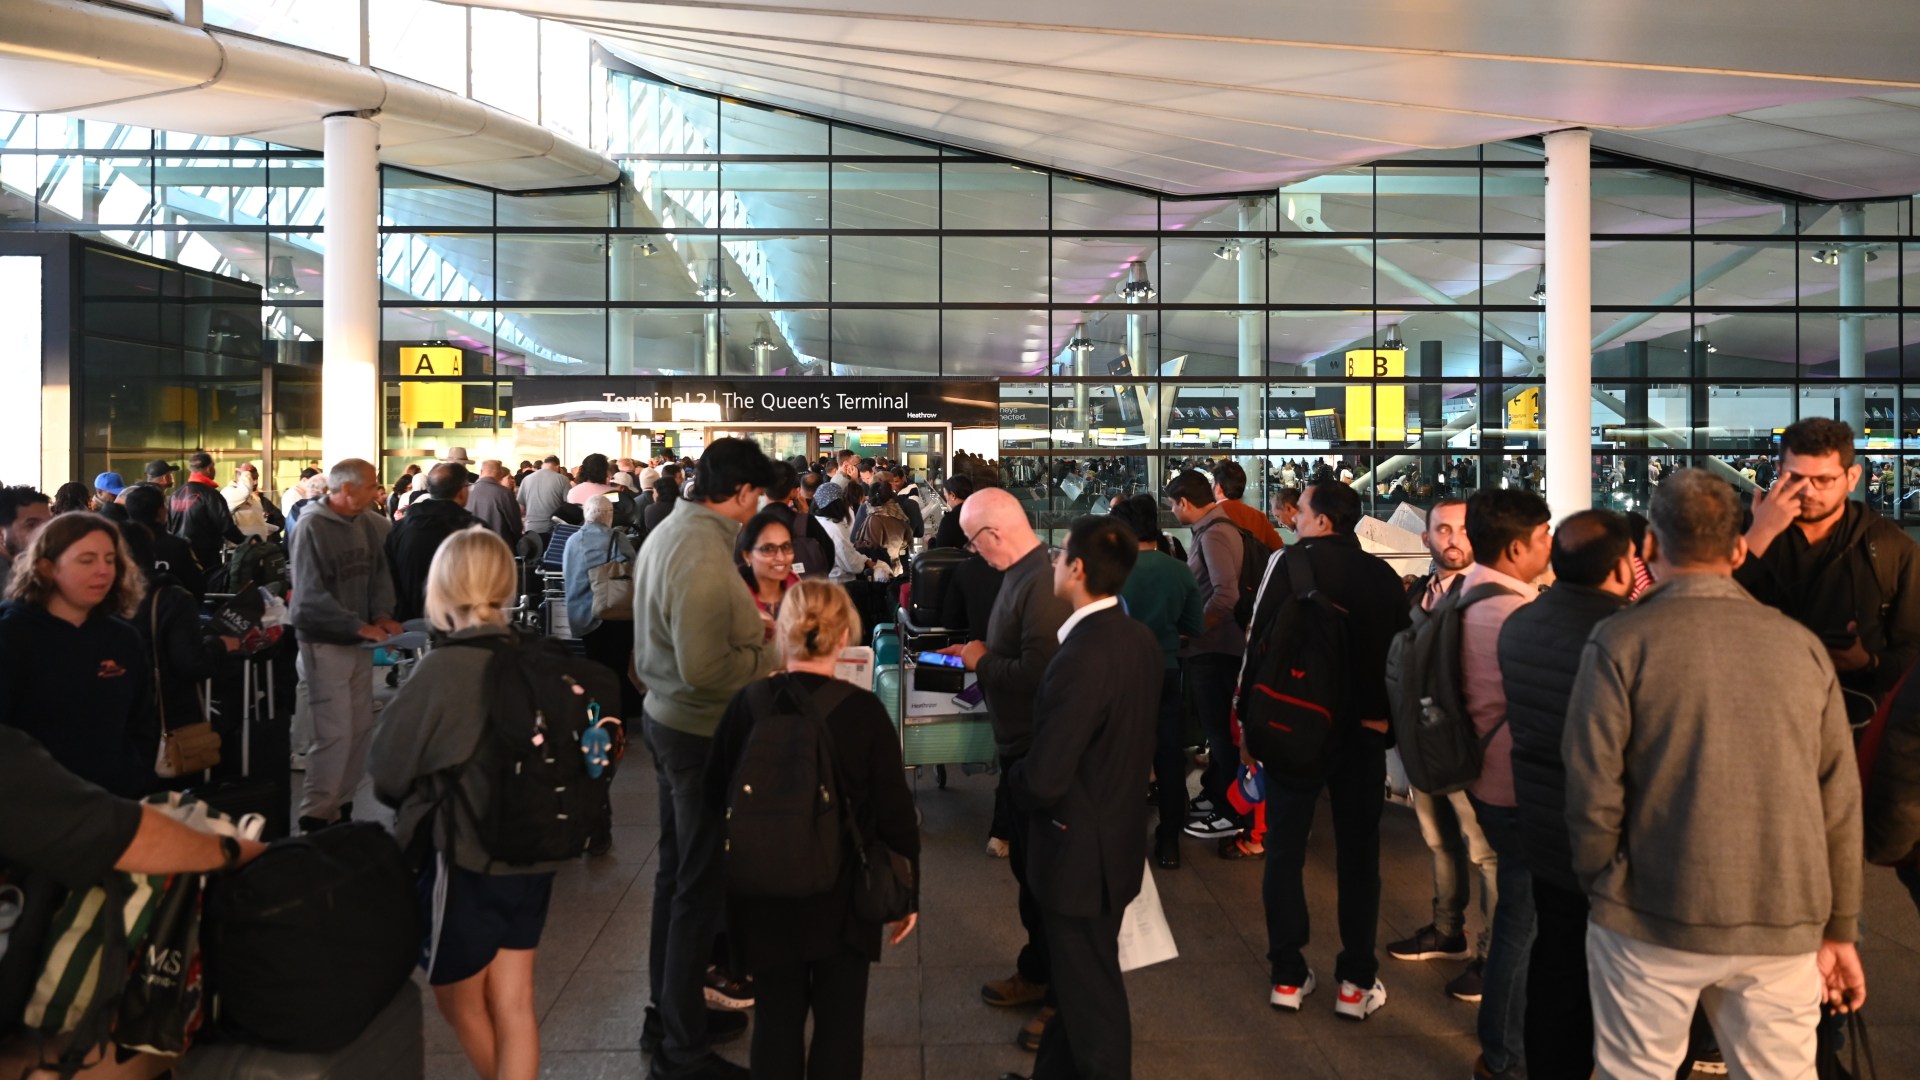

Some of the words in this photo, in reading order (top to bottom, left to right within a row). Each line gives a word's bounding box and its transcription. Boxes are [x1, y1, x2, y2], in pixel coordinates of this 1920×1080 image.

[415, 354, 435, 374] A
[1375, 356, 1388, 376] B
[722, 393, 754, 409] The
[761, 393, 831, 411] Queen’s
[836, 392, 908, 409] Terminal
[222, 608, 251, 630] M&S
